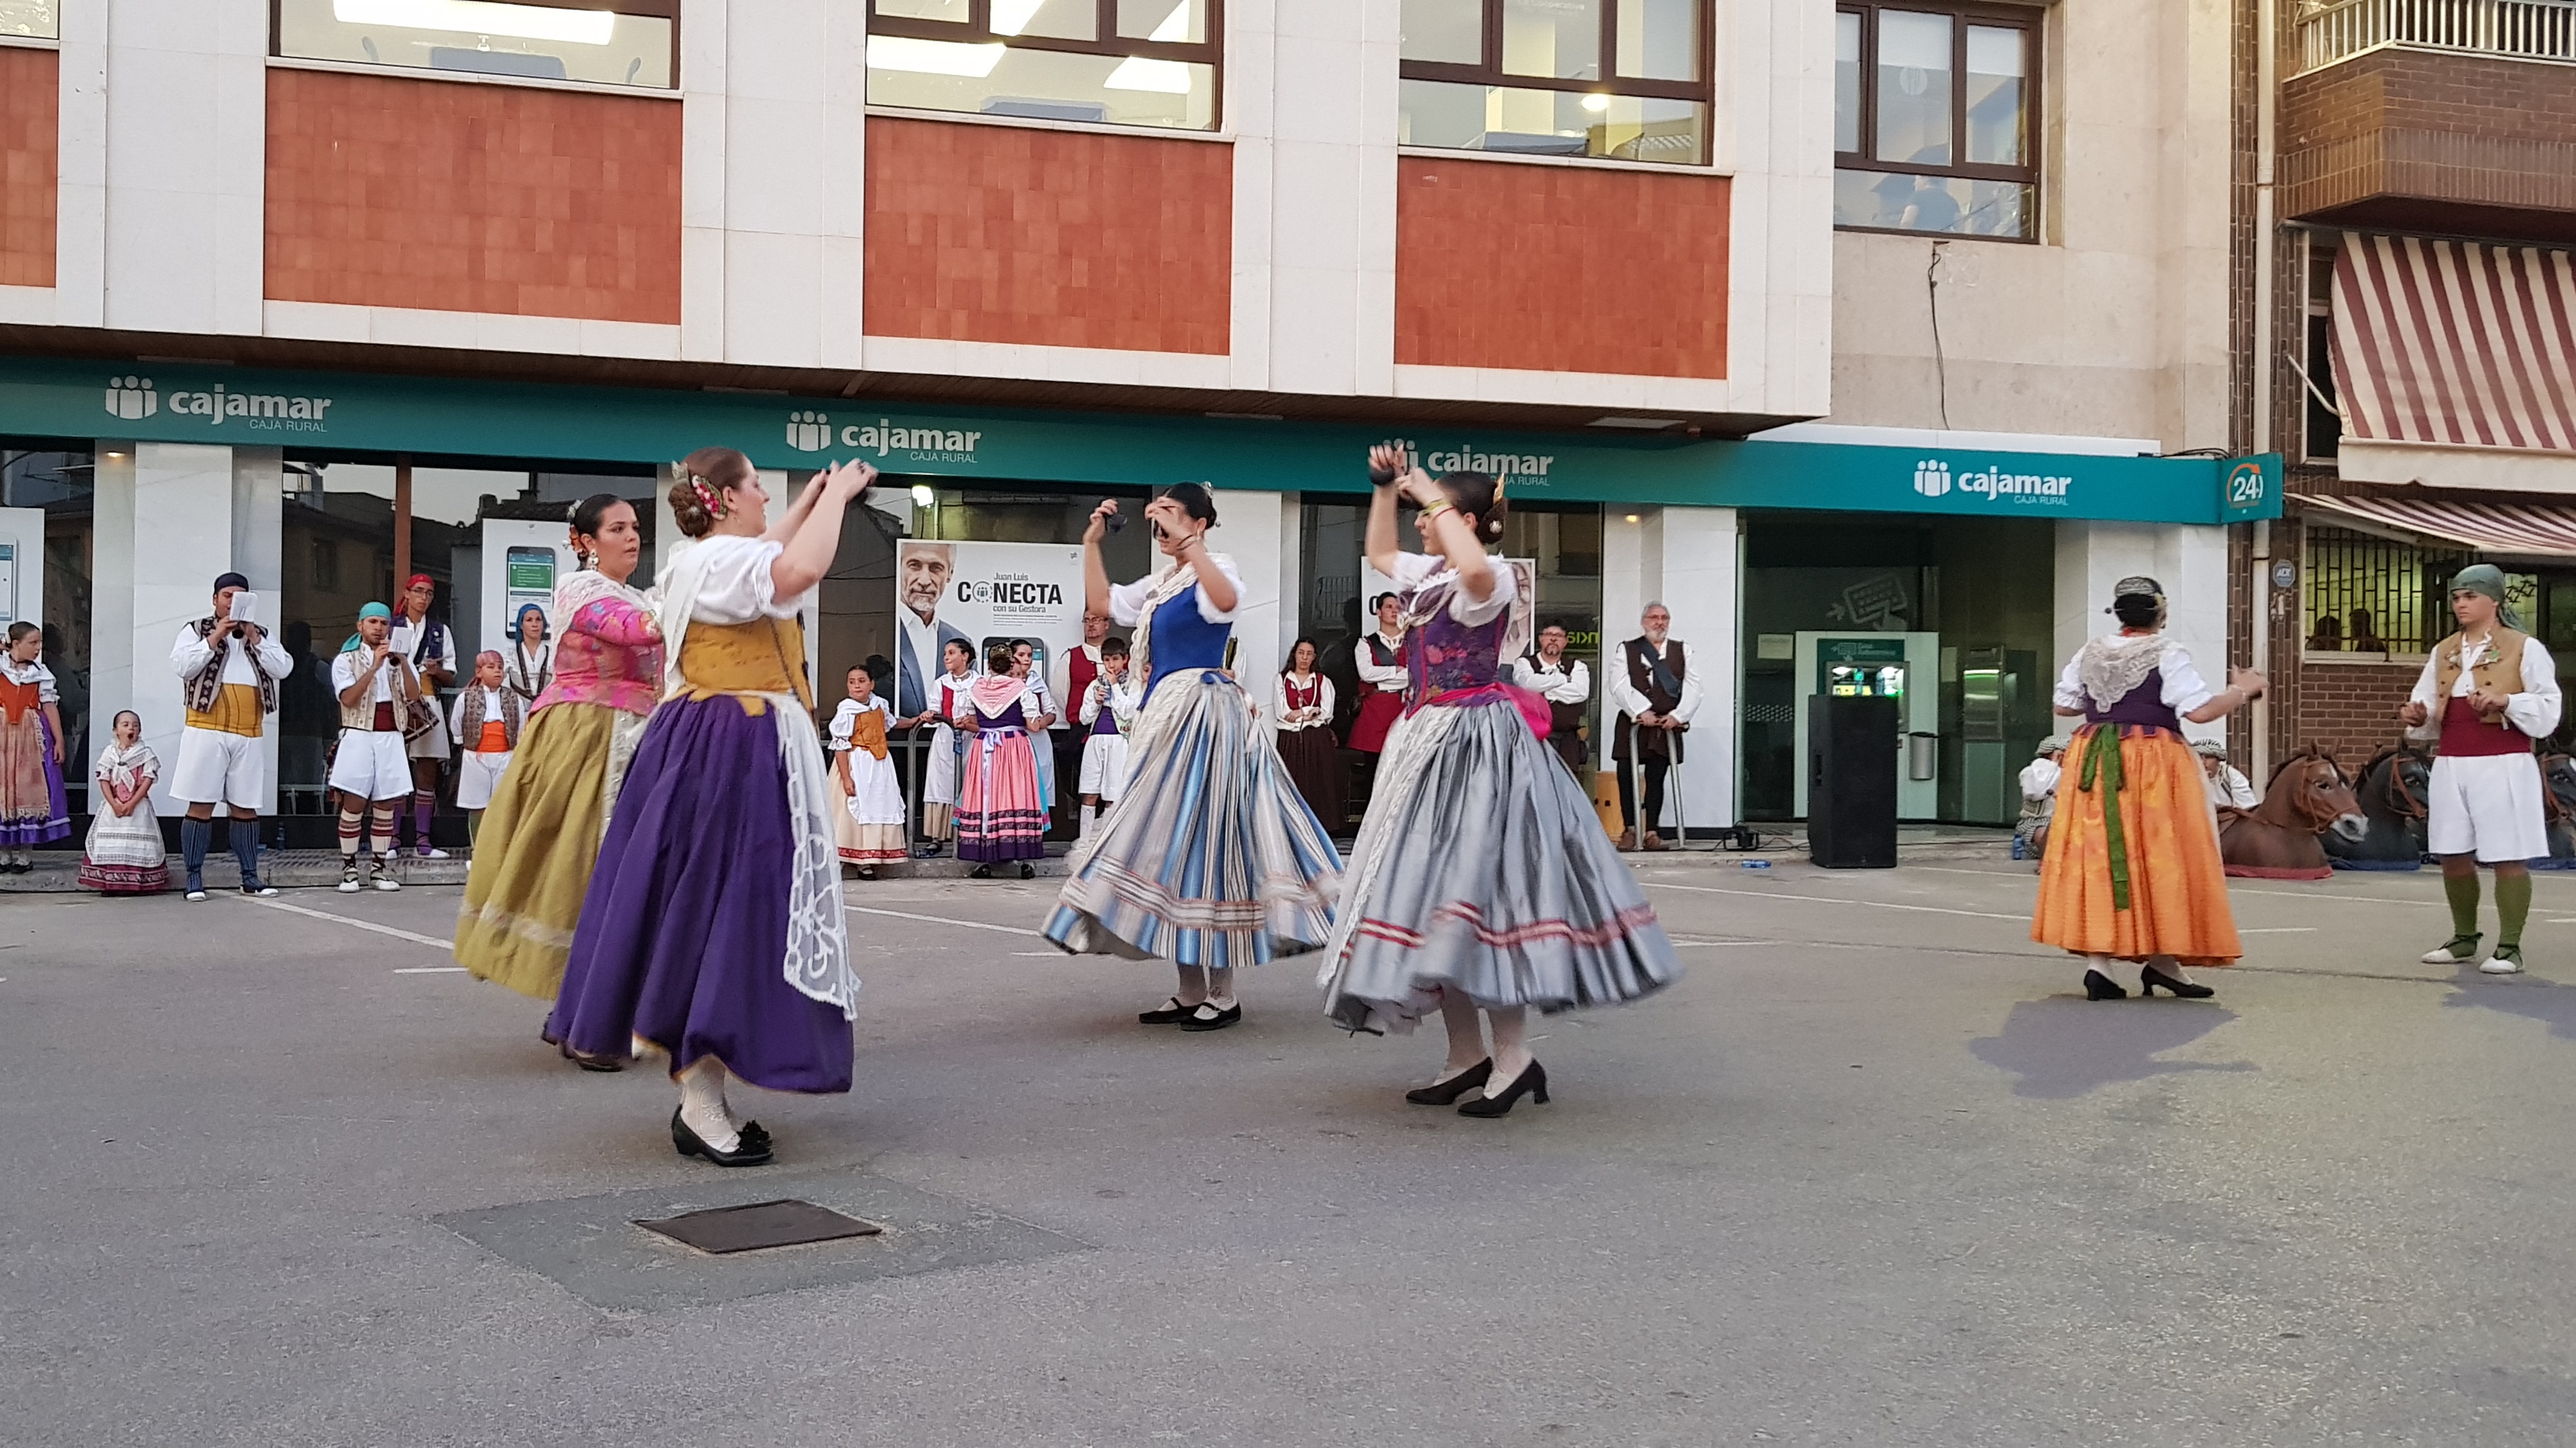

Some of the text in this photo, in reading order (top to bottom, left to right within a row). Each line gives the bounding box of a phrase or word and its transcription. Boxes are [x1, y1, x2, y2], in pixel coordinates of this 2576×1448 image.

[169, 383, 333, 424] cajamar
[249, 419, 328, 433] CAJA RURAL
[841, 419, 982, 457] cajamar
[910, 452, 978, 463] CAJA RURAL
[1518, 476, 1550, 487] RURAL
[1958, 465, 2072, 501] cajamar
[2014, 495, 2069, 506] CAJA RURAL
[993, 572, 1029, 581] Juan Luis
[1018, 605, 1047, 613] Gestora
